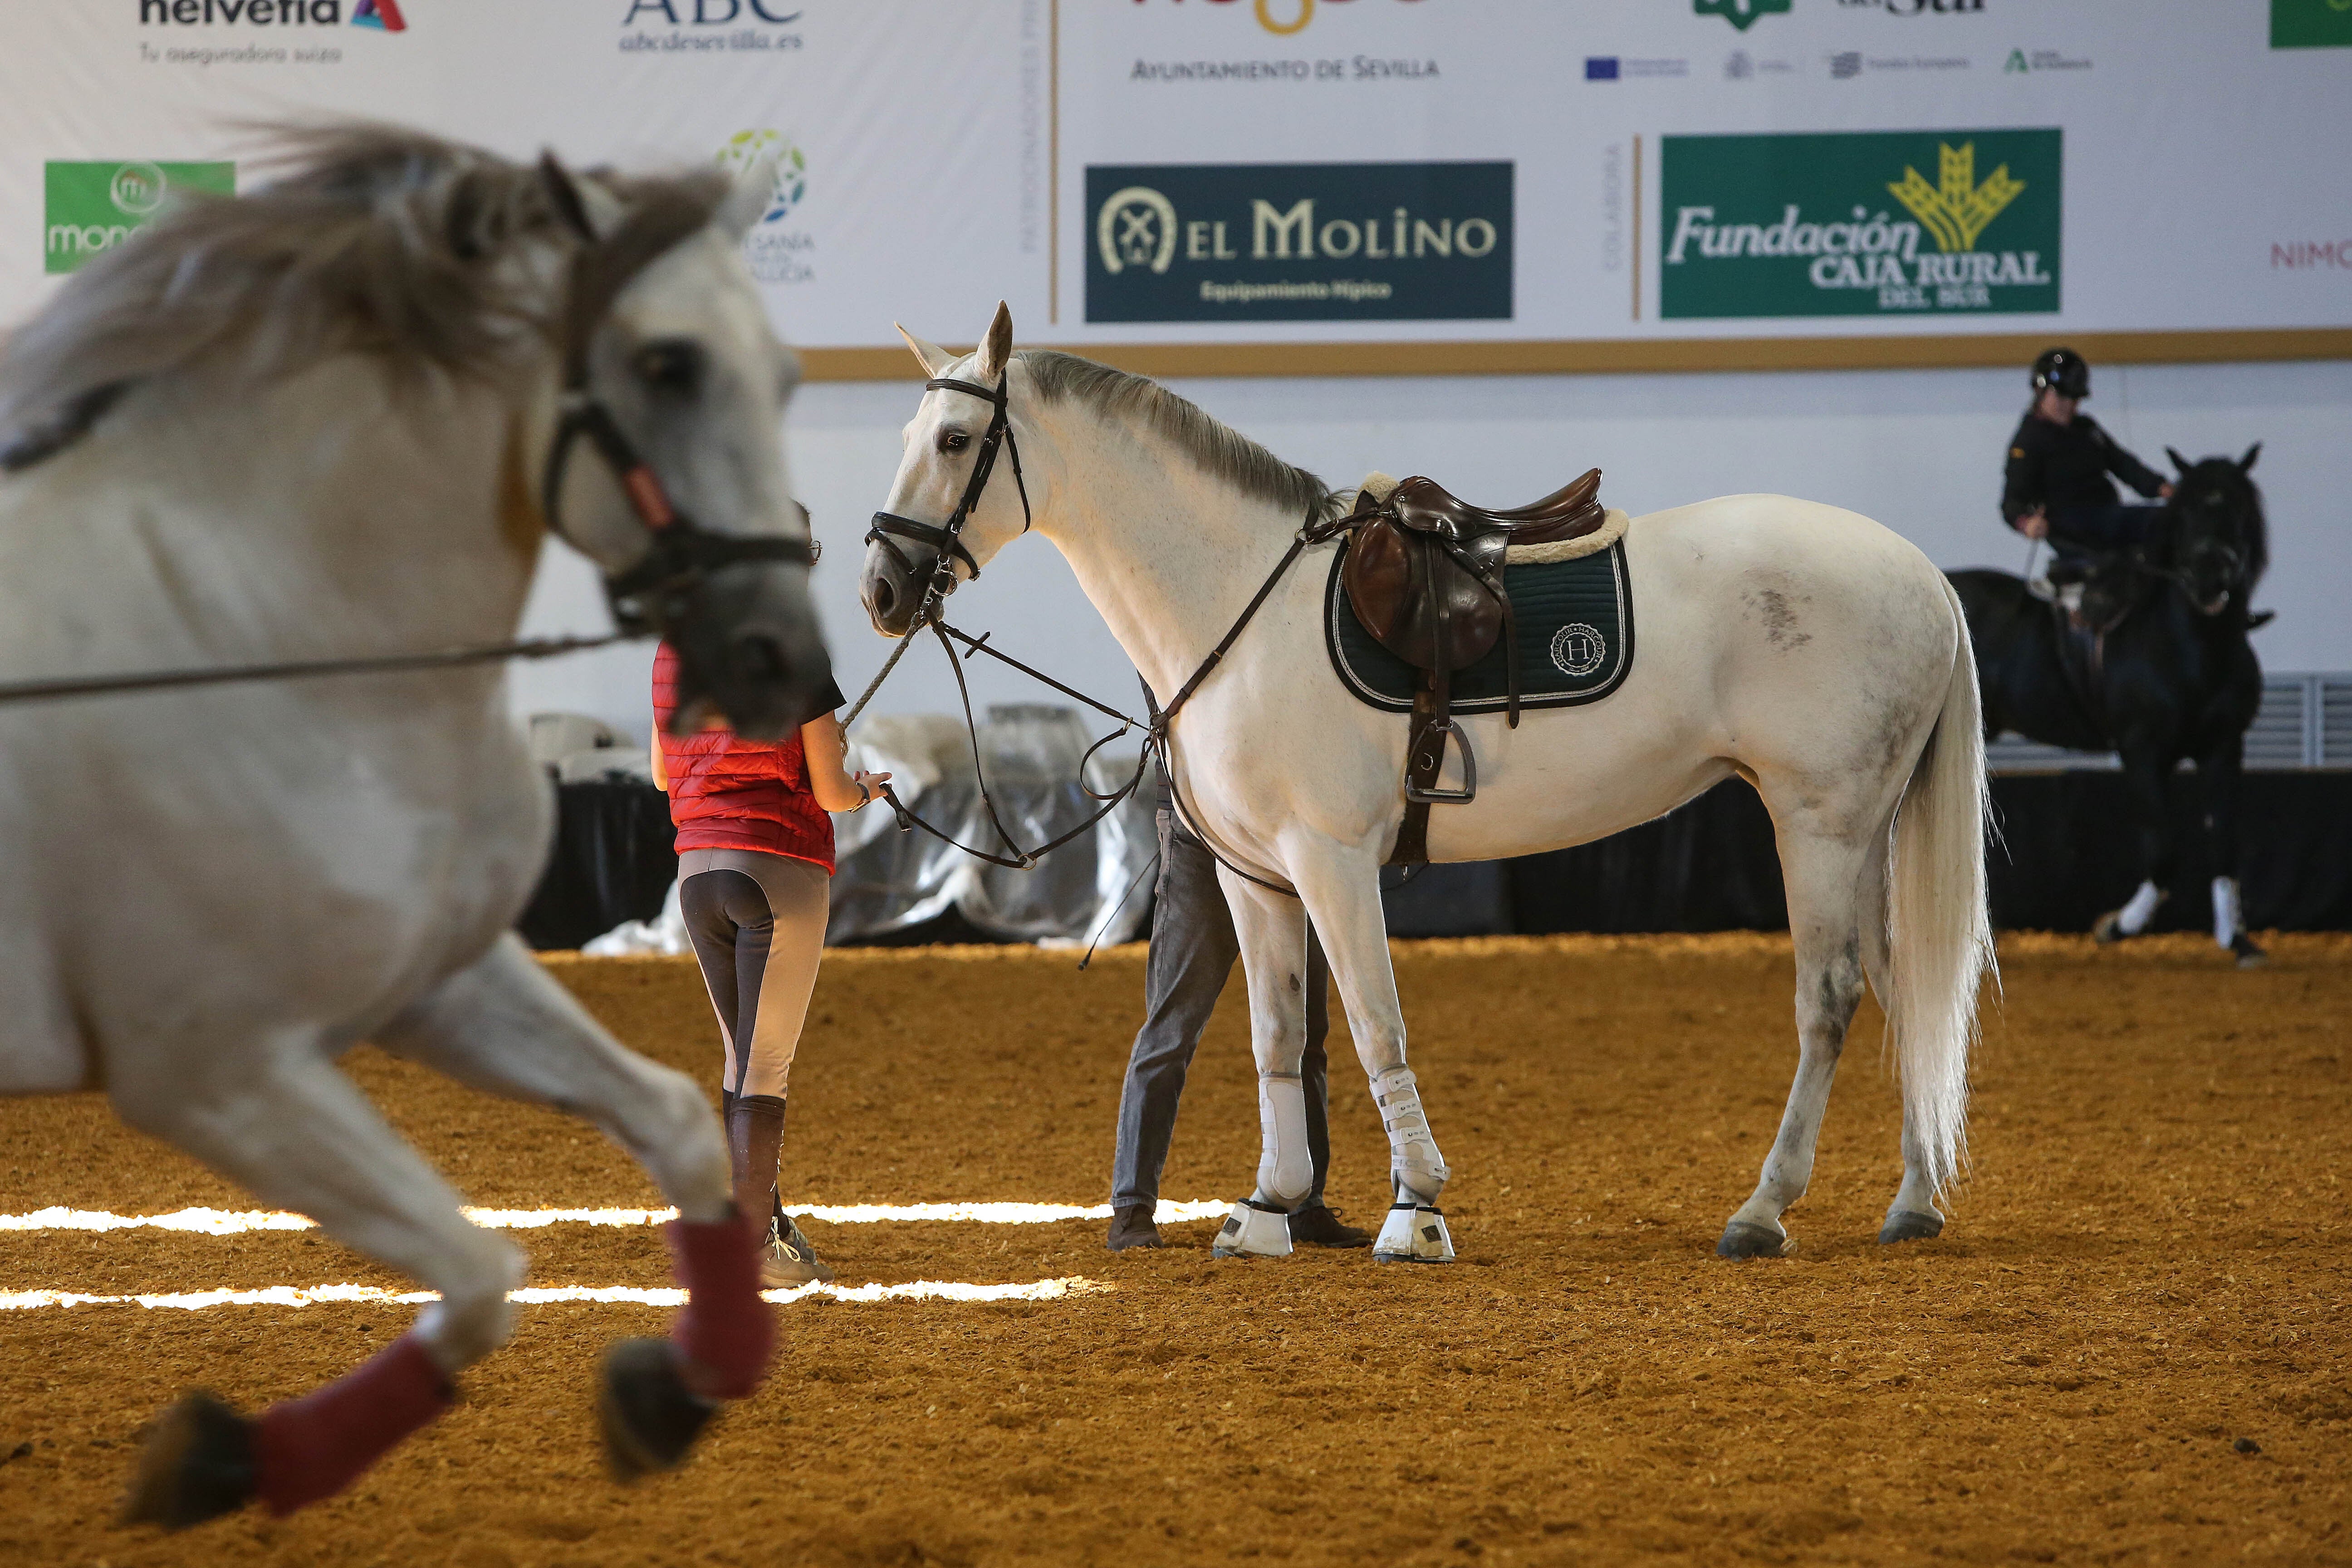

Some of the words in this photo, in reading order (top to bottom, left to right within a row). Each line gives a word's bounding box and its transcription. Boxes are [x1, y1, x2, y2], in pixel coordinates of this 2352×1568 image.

[166, 43, 287, 68] aseguradora
[1315, 59, 1343, 79] DE
[1350, 54, 1440, 79] SEVILLA
[1666, 203, 1922, 264] Fundación
[1808, 252, 1908, 289] CAJA
[1915, 250, 2051, 286] RURAL
[1554, 627, 1573, 663] HARCOUR
[1579, 627, 1602, 658] HARCOUR
[1566, 638, 1590, 661] H
